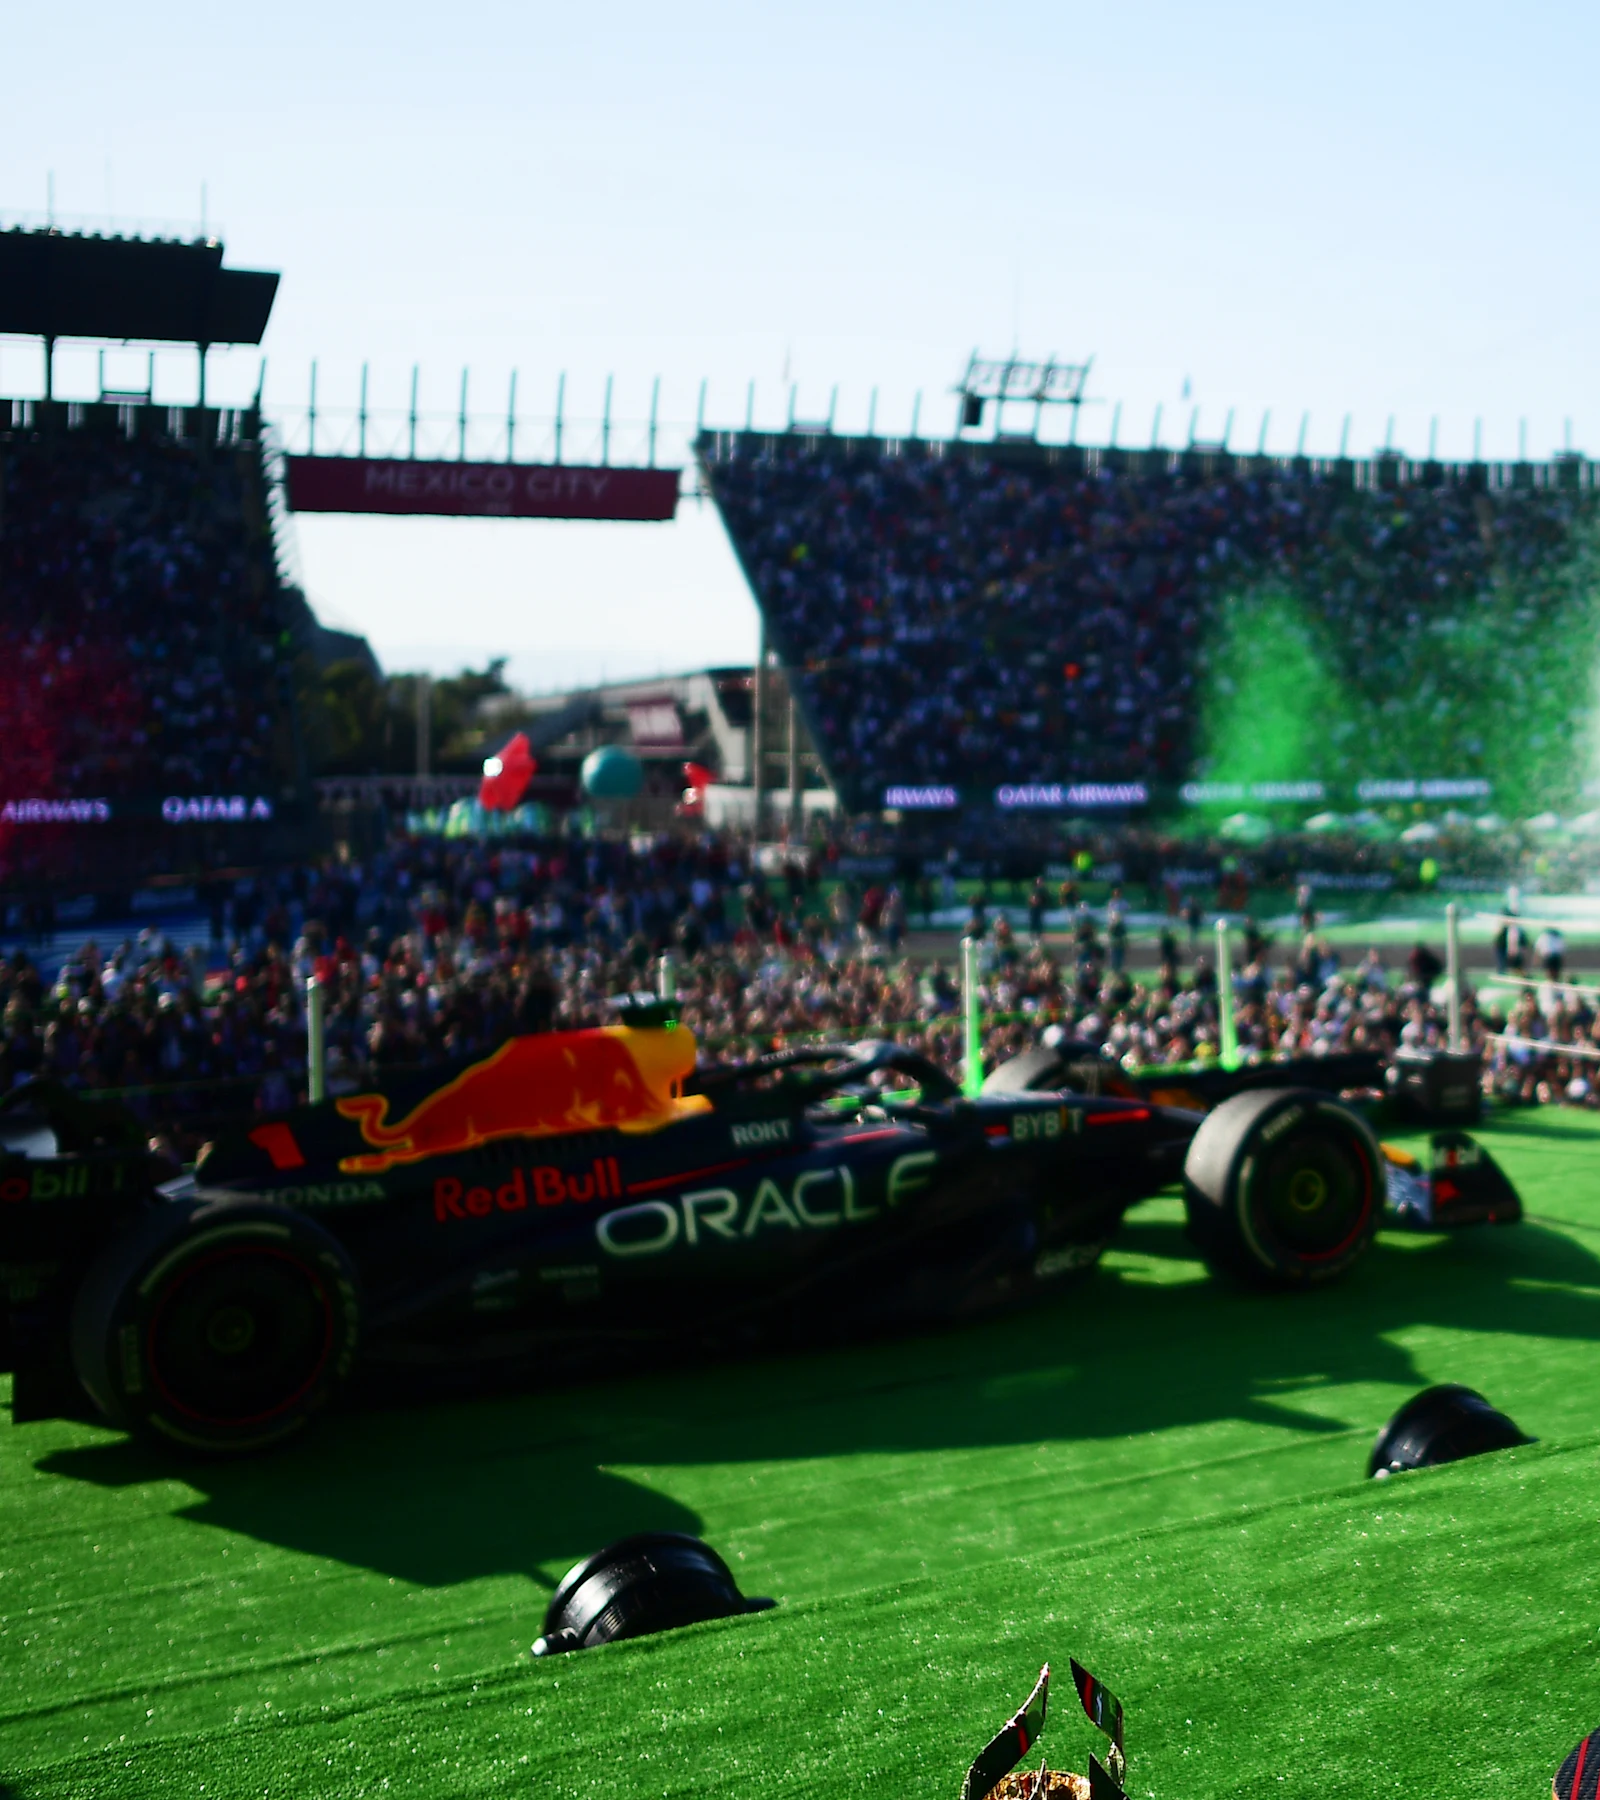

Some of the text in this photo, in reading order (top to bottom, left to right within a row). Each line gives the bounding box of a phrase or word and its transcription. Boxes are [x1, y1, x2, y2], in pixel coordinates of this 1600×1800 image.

[364, 464, 611, 499] MEXICO CITY
[1, 799, 108, 822] AIRWAYS
[162, 797, 246, 823] QATAR
[998, 782, 1147, 806] QATAR AIRWAYS
[730, 1117, 792, 1149] ROKT
[1012, 1106, 1083, 1142] BYBIT
[248, 1122, 308, 1171] 1
[432, 1154, 623, 1224] Red Bull
[595, 1149, 940, 1258] ORACLE
